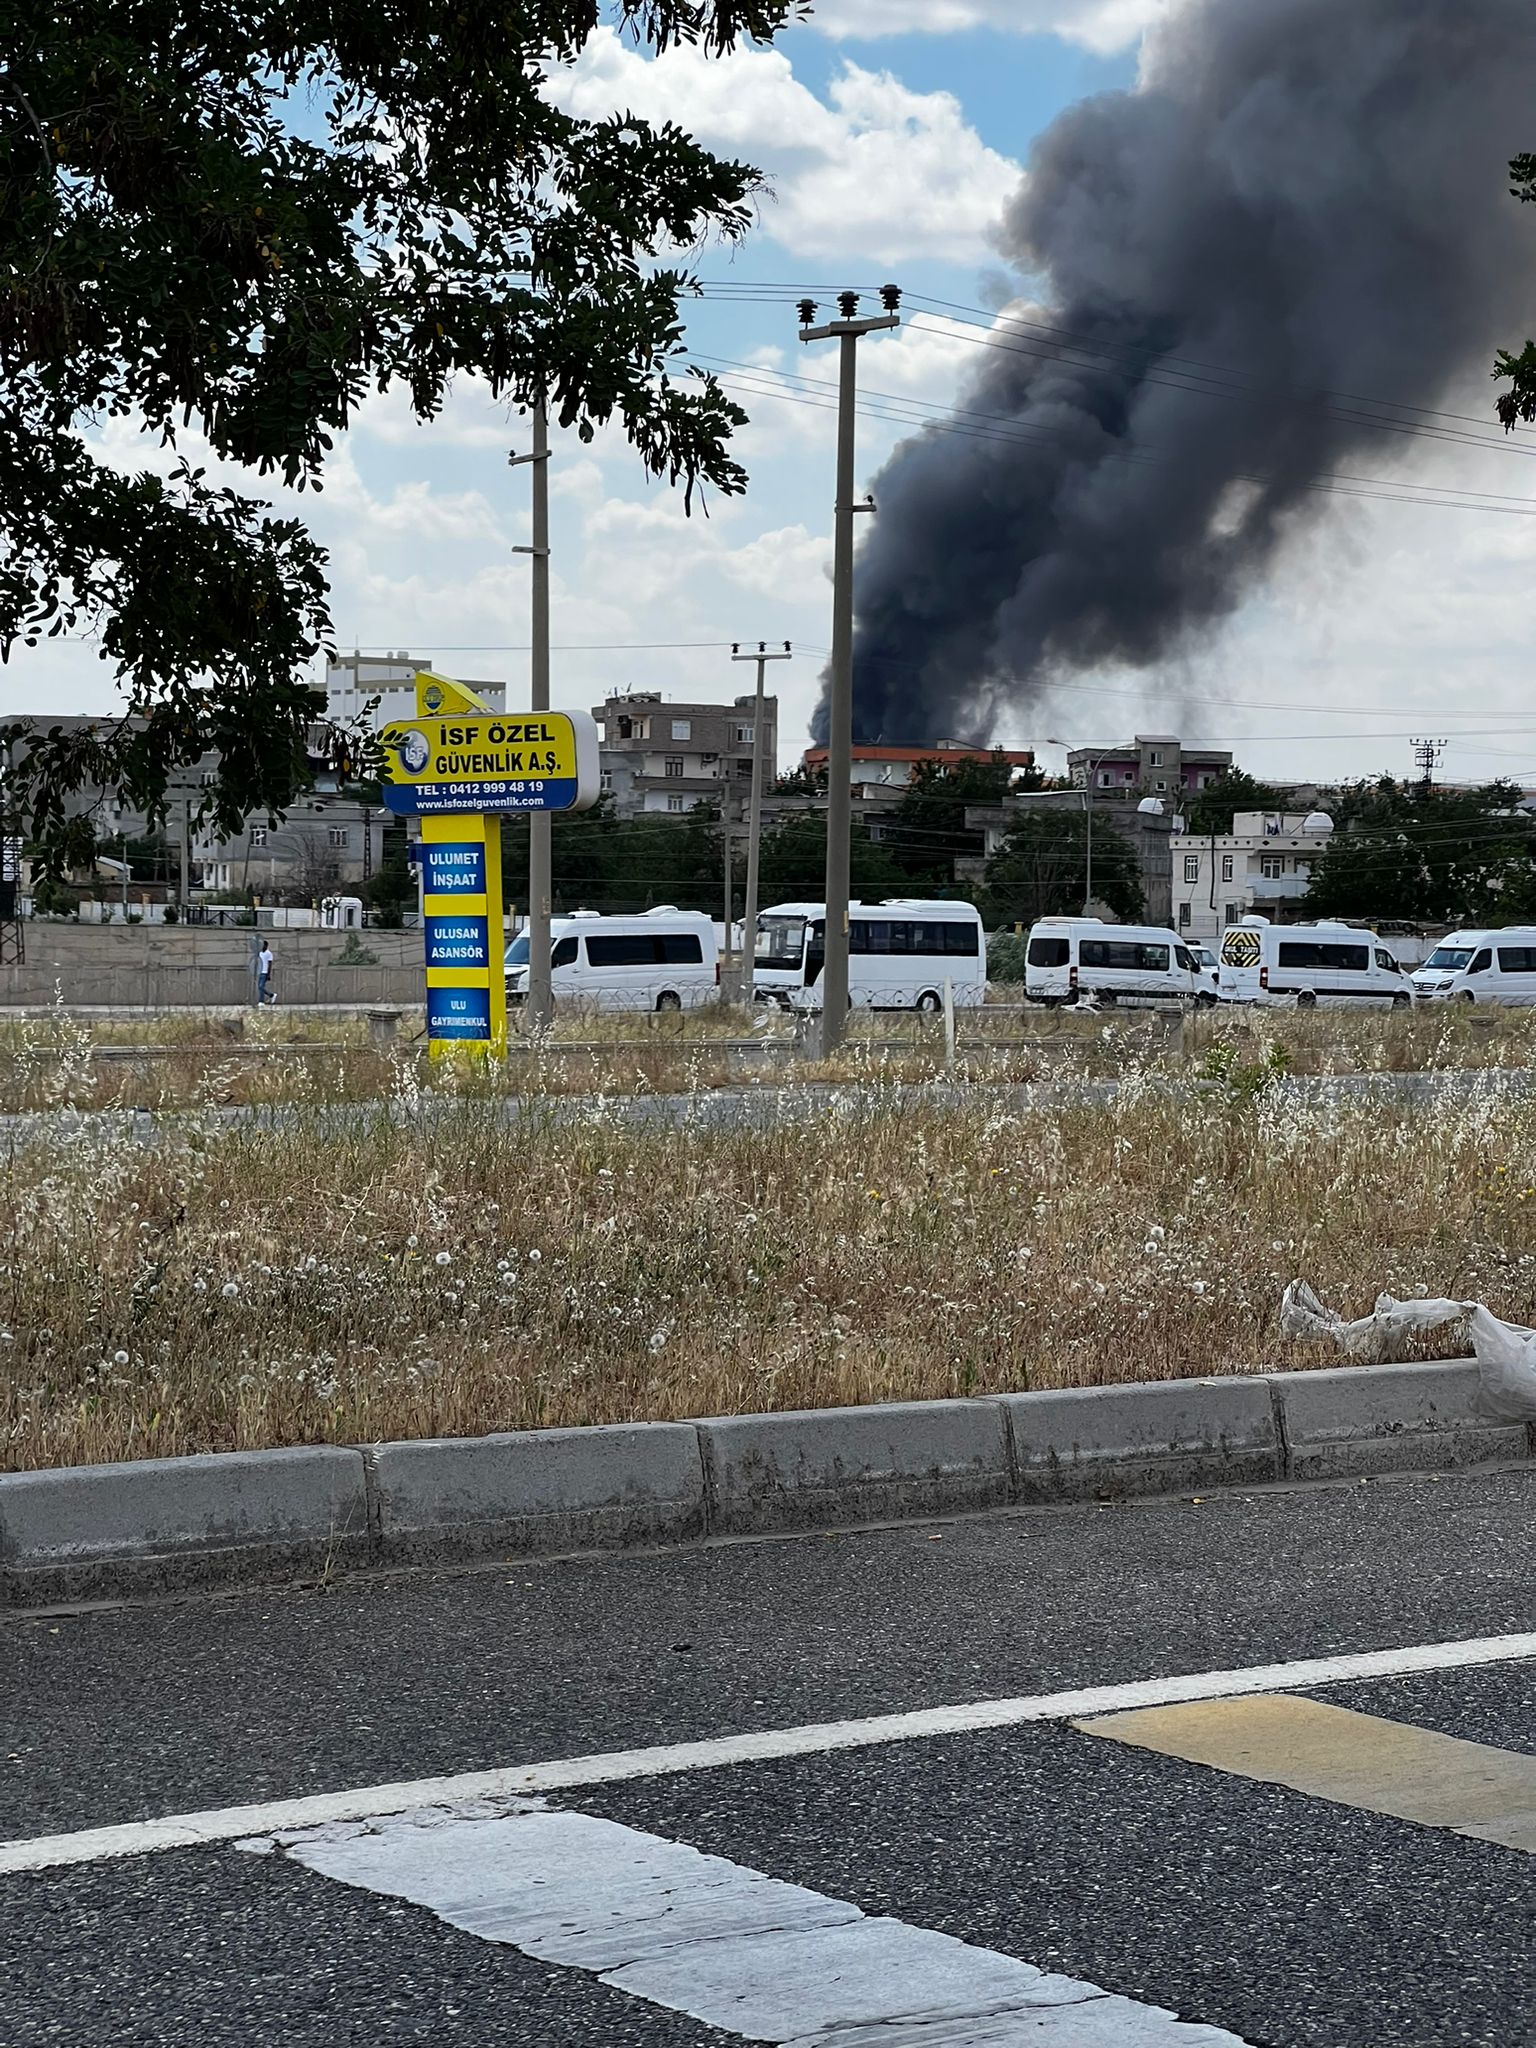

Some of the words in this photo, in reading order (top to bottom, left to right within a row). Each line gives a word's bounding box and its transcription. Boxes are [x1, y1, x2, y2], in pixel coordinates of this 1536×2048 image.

[440, 724, 479, 746] İSF
[488, 722, 555, 743] ÖZEL
[436, 749, 523, 775] GÜVENLİK
[528, 750, 561, 775] A.Ş.
[415, 785, 439, 796] TEL
[449, 783, 480, 794] 0412
[483, 782, 507, 793] 999
[509, 782, 525, 793] 48
[529, 781, 544, 792] 19
[416, 796, 544, 809] www.isfozelguvenlik.com
[429, 852, 479, 865] ULUMET
[432, 872, 477, 888] İNŞAAT
[434, 928, 478, 939] ULUSAN
[431, 944, 484, 959] ASANSÖR
[450, 1000, 466, 1010] ULU
